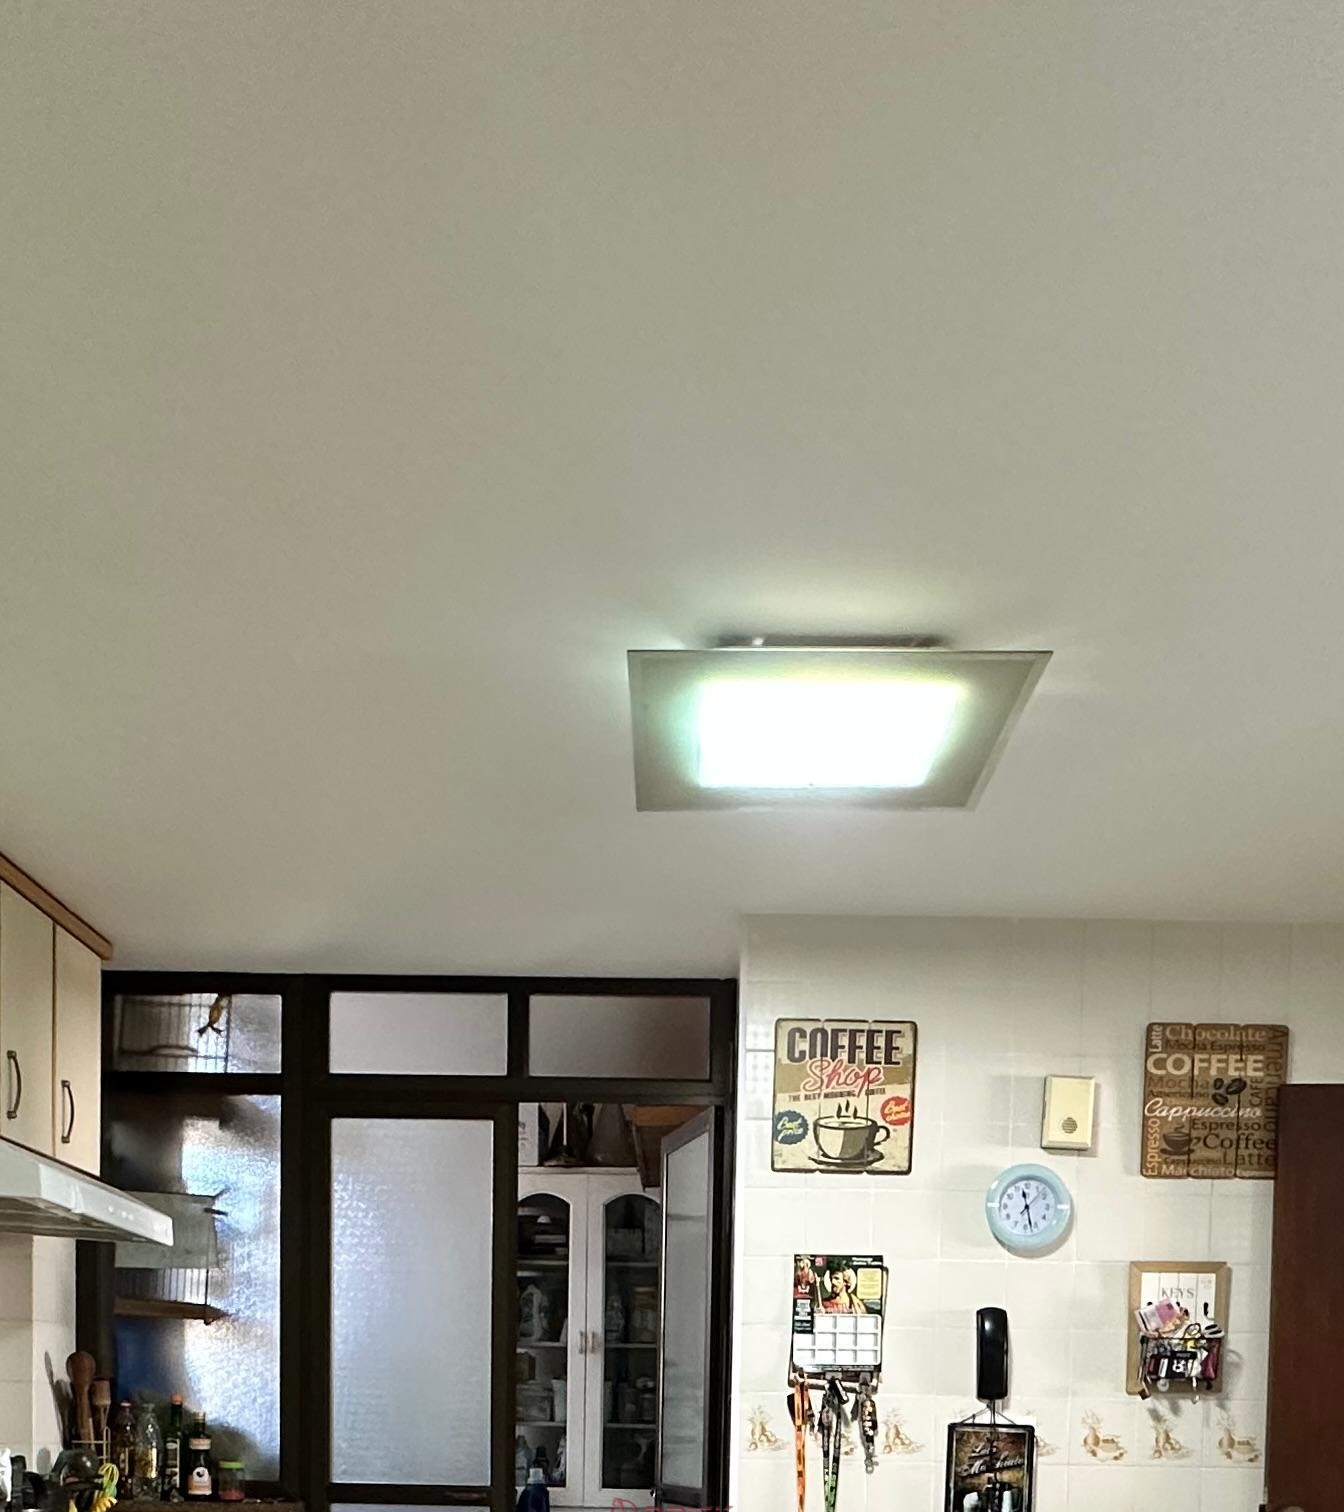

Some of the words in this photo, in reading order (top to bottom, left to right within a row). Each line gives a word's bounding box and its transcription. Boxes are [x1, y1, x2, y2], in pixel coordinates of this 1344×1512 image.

[1149, 1024, 1163, 1053] Latte
[1166, 1025, 1267, 1041] Chocolate
[787, 1027, 904, 1065] COFFEE
[1146, 1053, 1264, 1076] COFFEE
[801, 1059, 883, 1097] Shop
[1148, 1076, 1210, 1089] Mocha
[1144, 1097, 1262, 1121] Cappuccino
[1192, 1119, 1262, 1132] Espresso
[1143, 1118, 1162, 1176] Espresso
[1203, 1132, 1276, 1150] Coffee
[1161, 1164, 1235, 1177] Macchiato
[1161, 1287, 1194, 1299] KEYS
